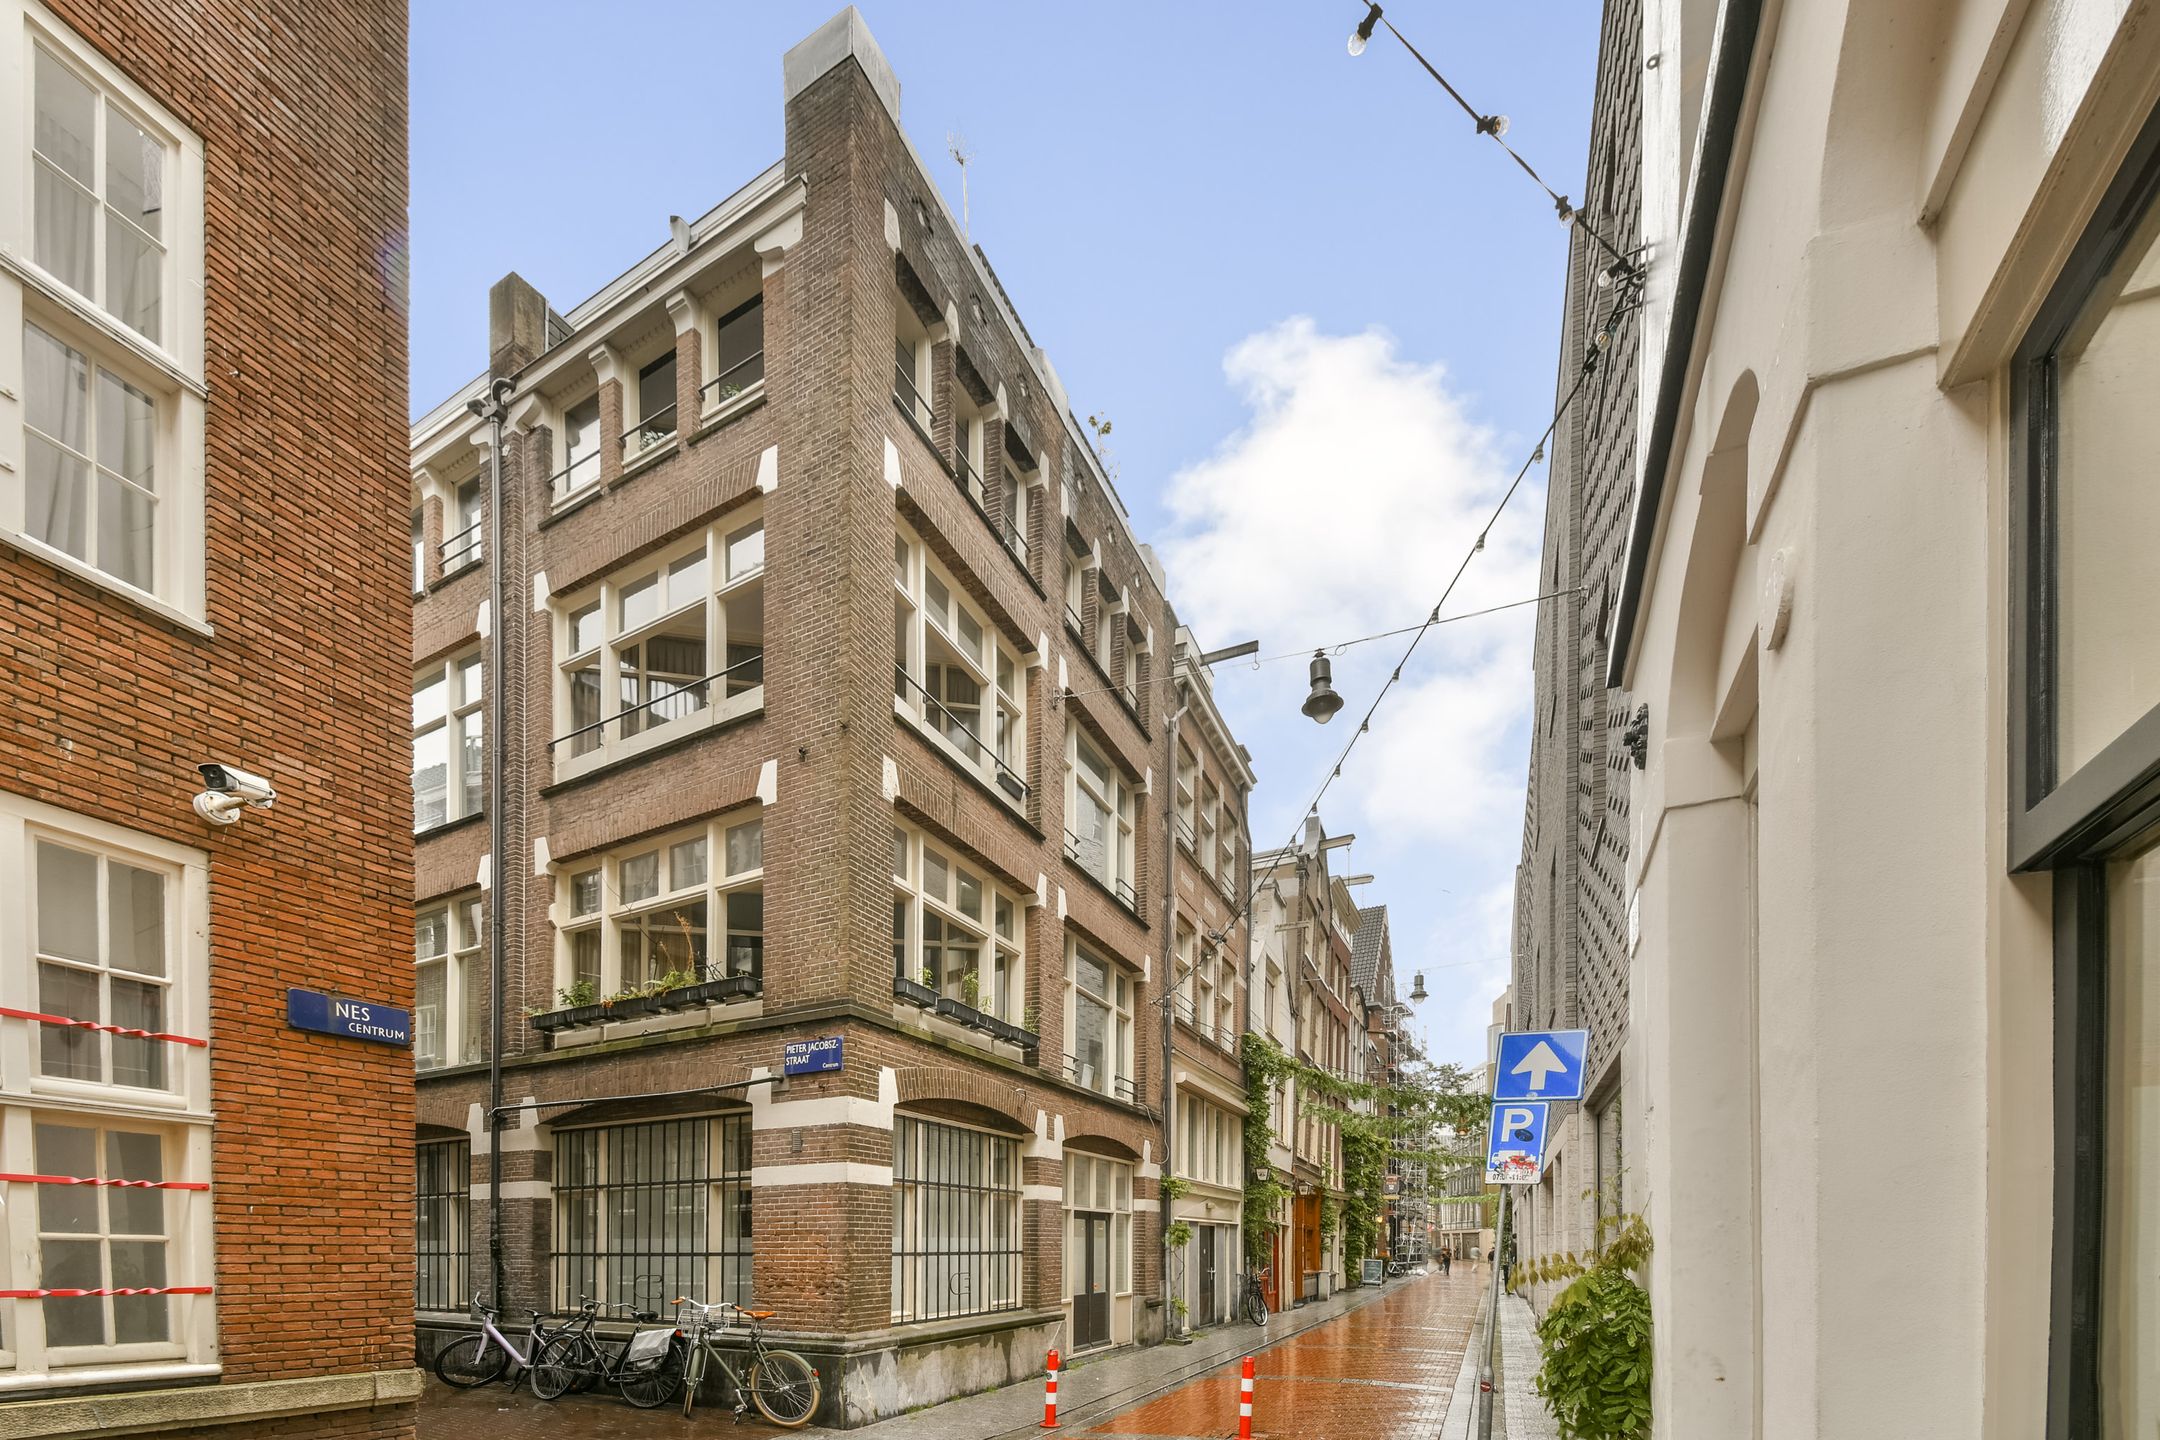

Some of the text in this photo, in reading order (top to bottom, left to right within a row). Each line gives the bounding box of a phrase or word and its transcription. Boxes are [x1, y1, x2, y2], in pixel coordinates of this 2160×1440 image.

[335, 1002, 370, 1021] NES
[348, 1022, 404, 1040] CENTRUM
[786, 1044, 807, 1054] PIETER
[786, 1055, 810, 1066] STRAAT
[1501, 1108, 1534, 1142] P
